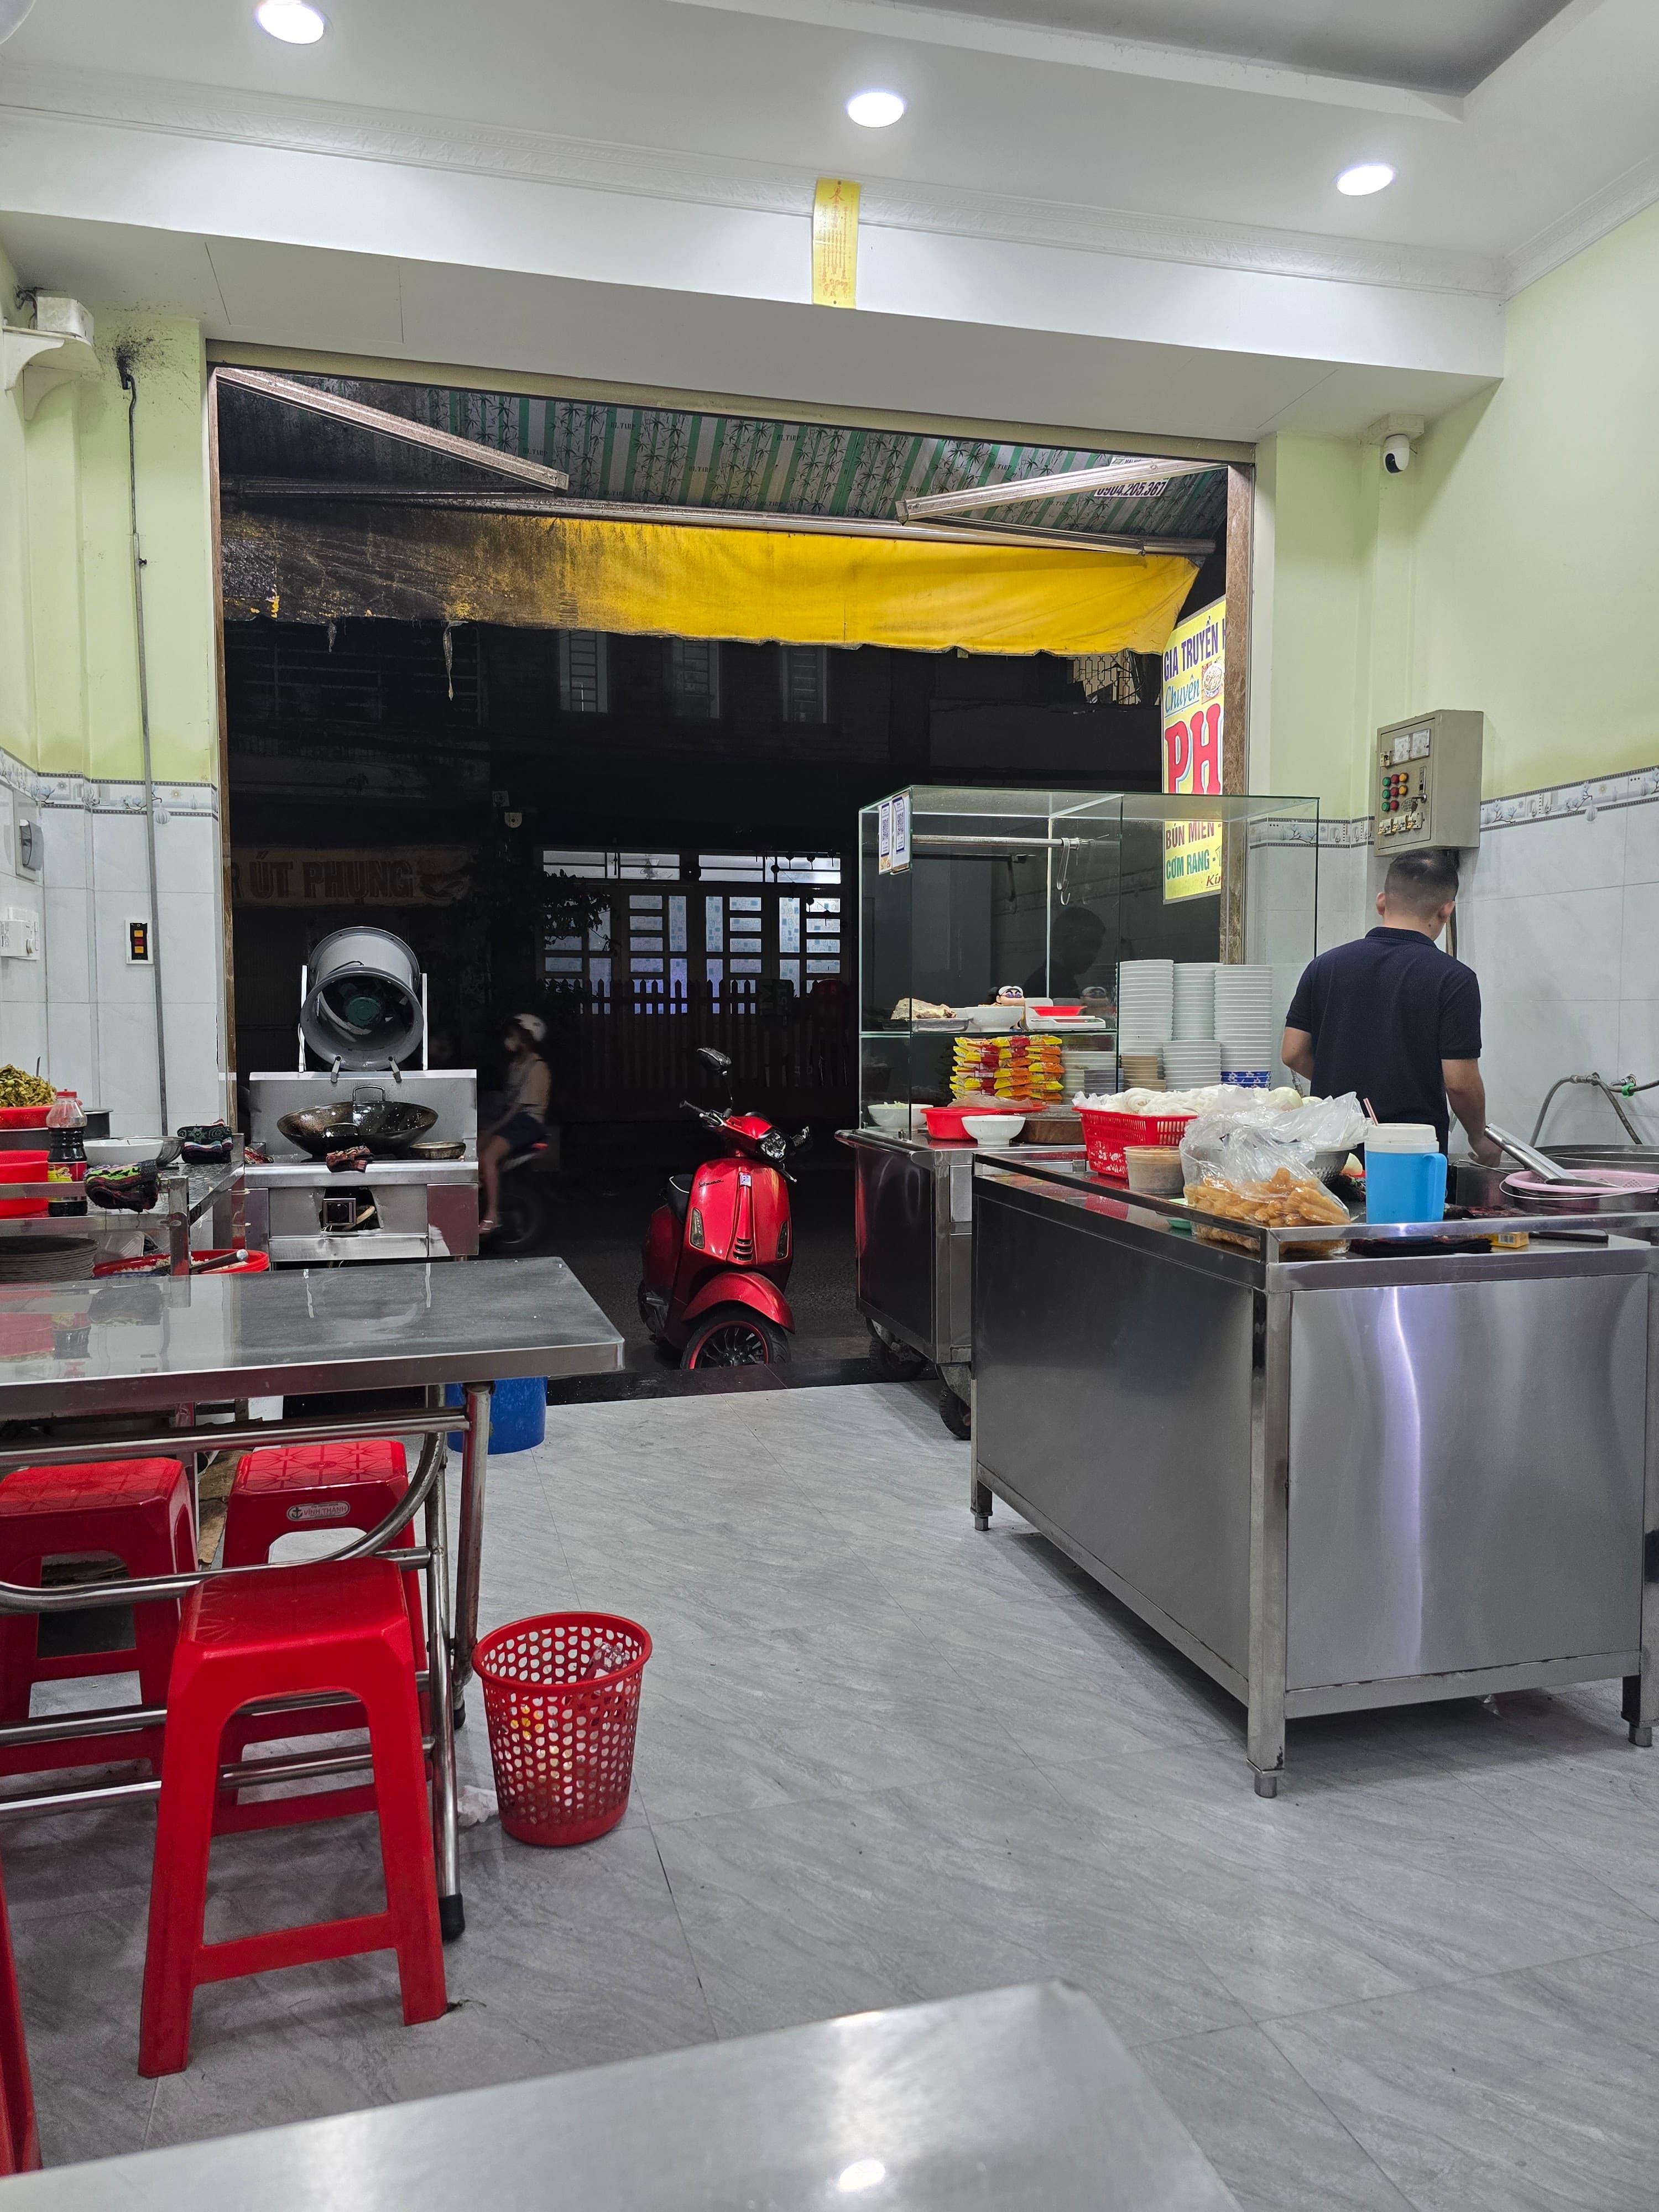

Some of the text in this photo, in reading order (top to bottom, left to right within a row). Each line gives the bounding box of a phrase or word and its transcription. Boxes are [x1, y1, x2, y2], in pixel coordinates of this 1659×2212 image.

[1164, 646, 1178, 681] GIA
[1181, 615, 1218, 671] TRUYỀN
[1165, 673, 1199, 713] Chuyên
[1166, 823, 1185, 850] BÚN
[1166, 855, 1184, 880] CƠM
[1187, 849, 1210, 875] RANG
